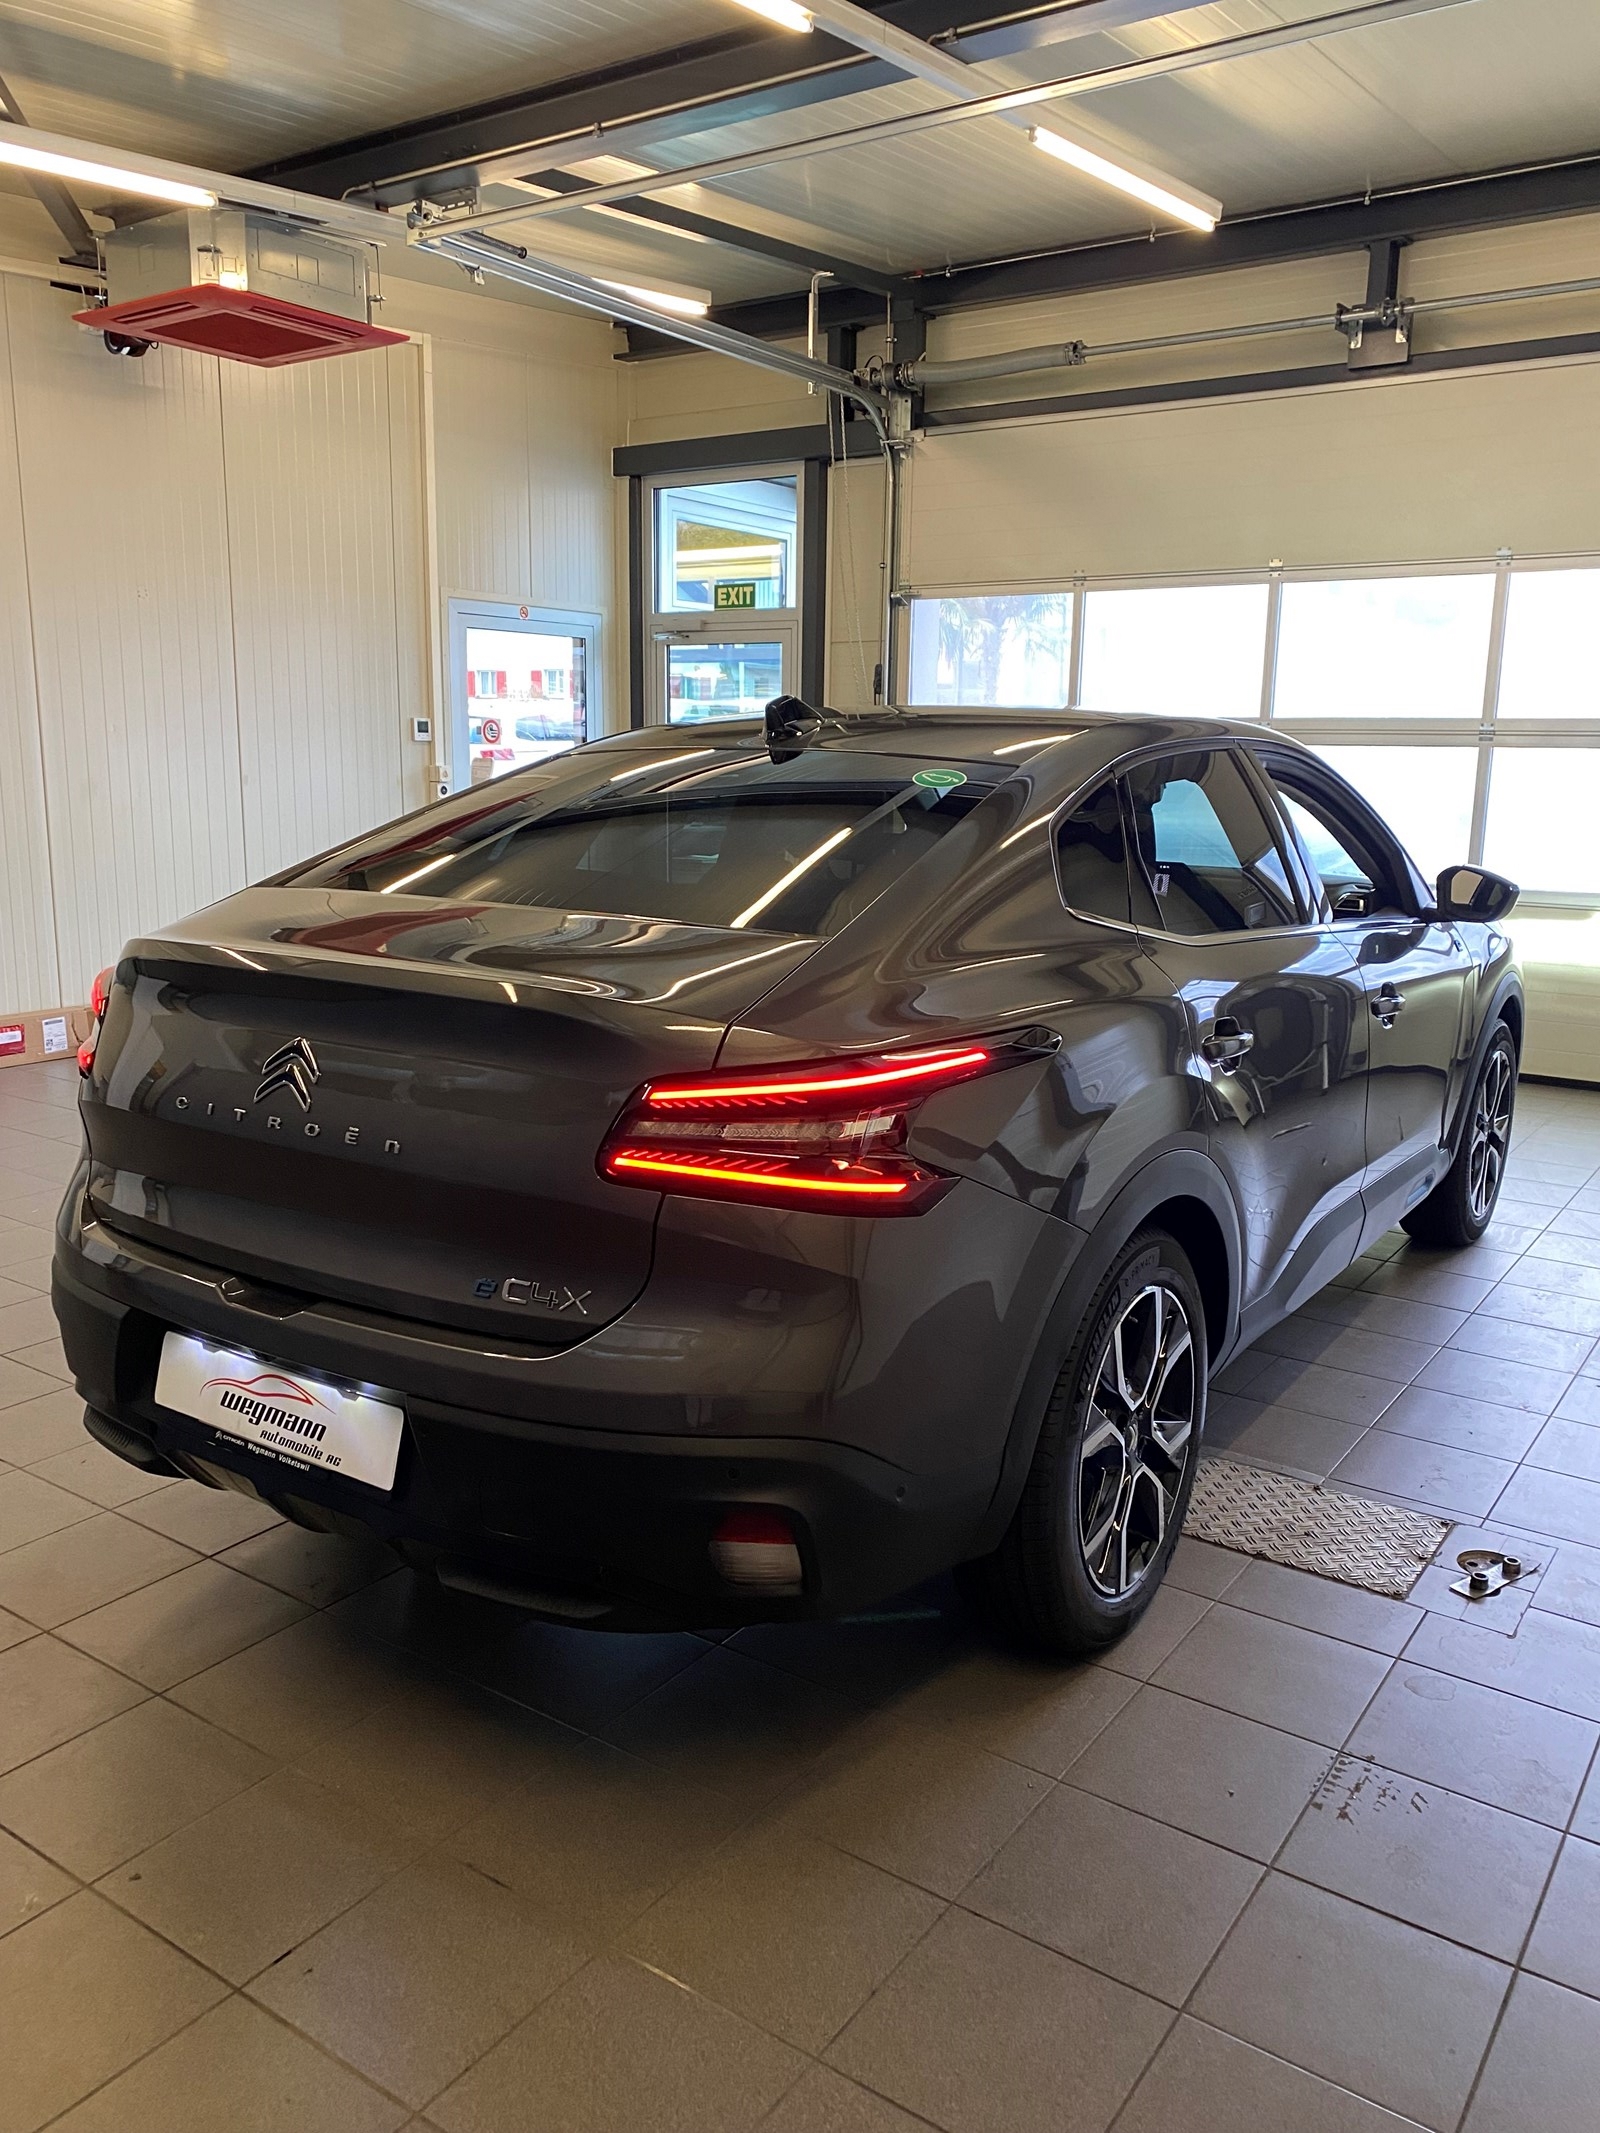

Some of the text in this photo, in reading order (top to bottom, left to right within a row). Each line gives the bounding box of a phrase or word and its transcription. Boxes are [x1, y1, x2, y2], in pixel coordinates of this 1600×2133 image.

[717, 586, 752, 605] EXIT
[220, 1391, 326, 1441] wegmann
[247, 1442, 277, 1459] Wegmann
[278, 1453, 311, 1472] Volketswil
[325, 1453, 342, 1468] AG
